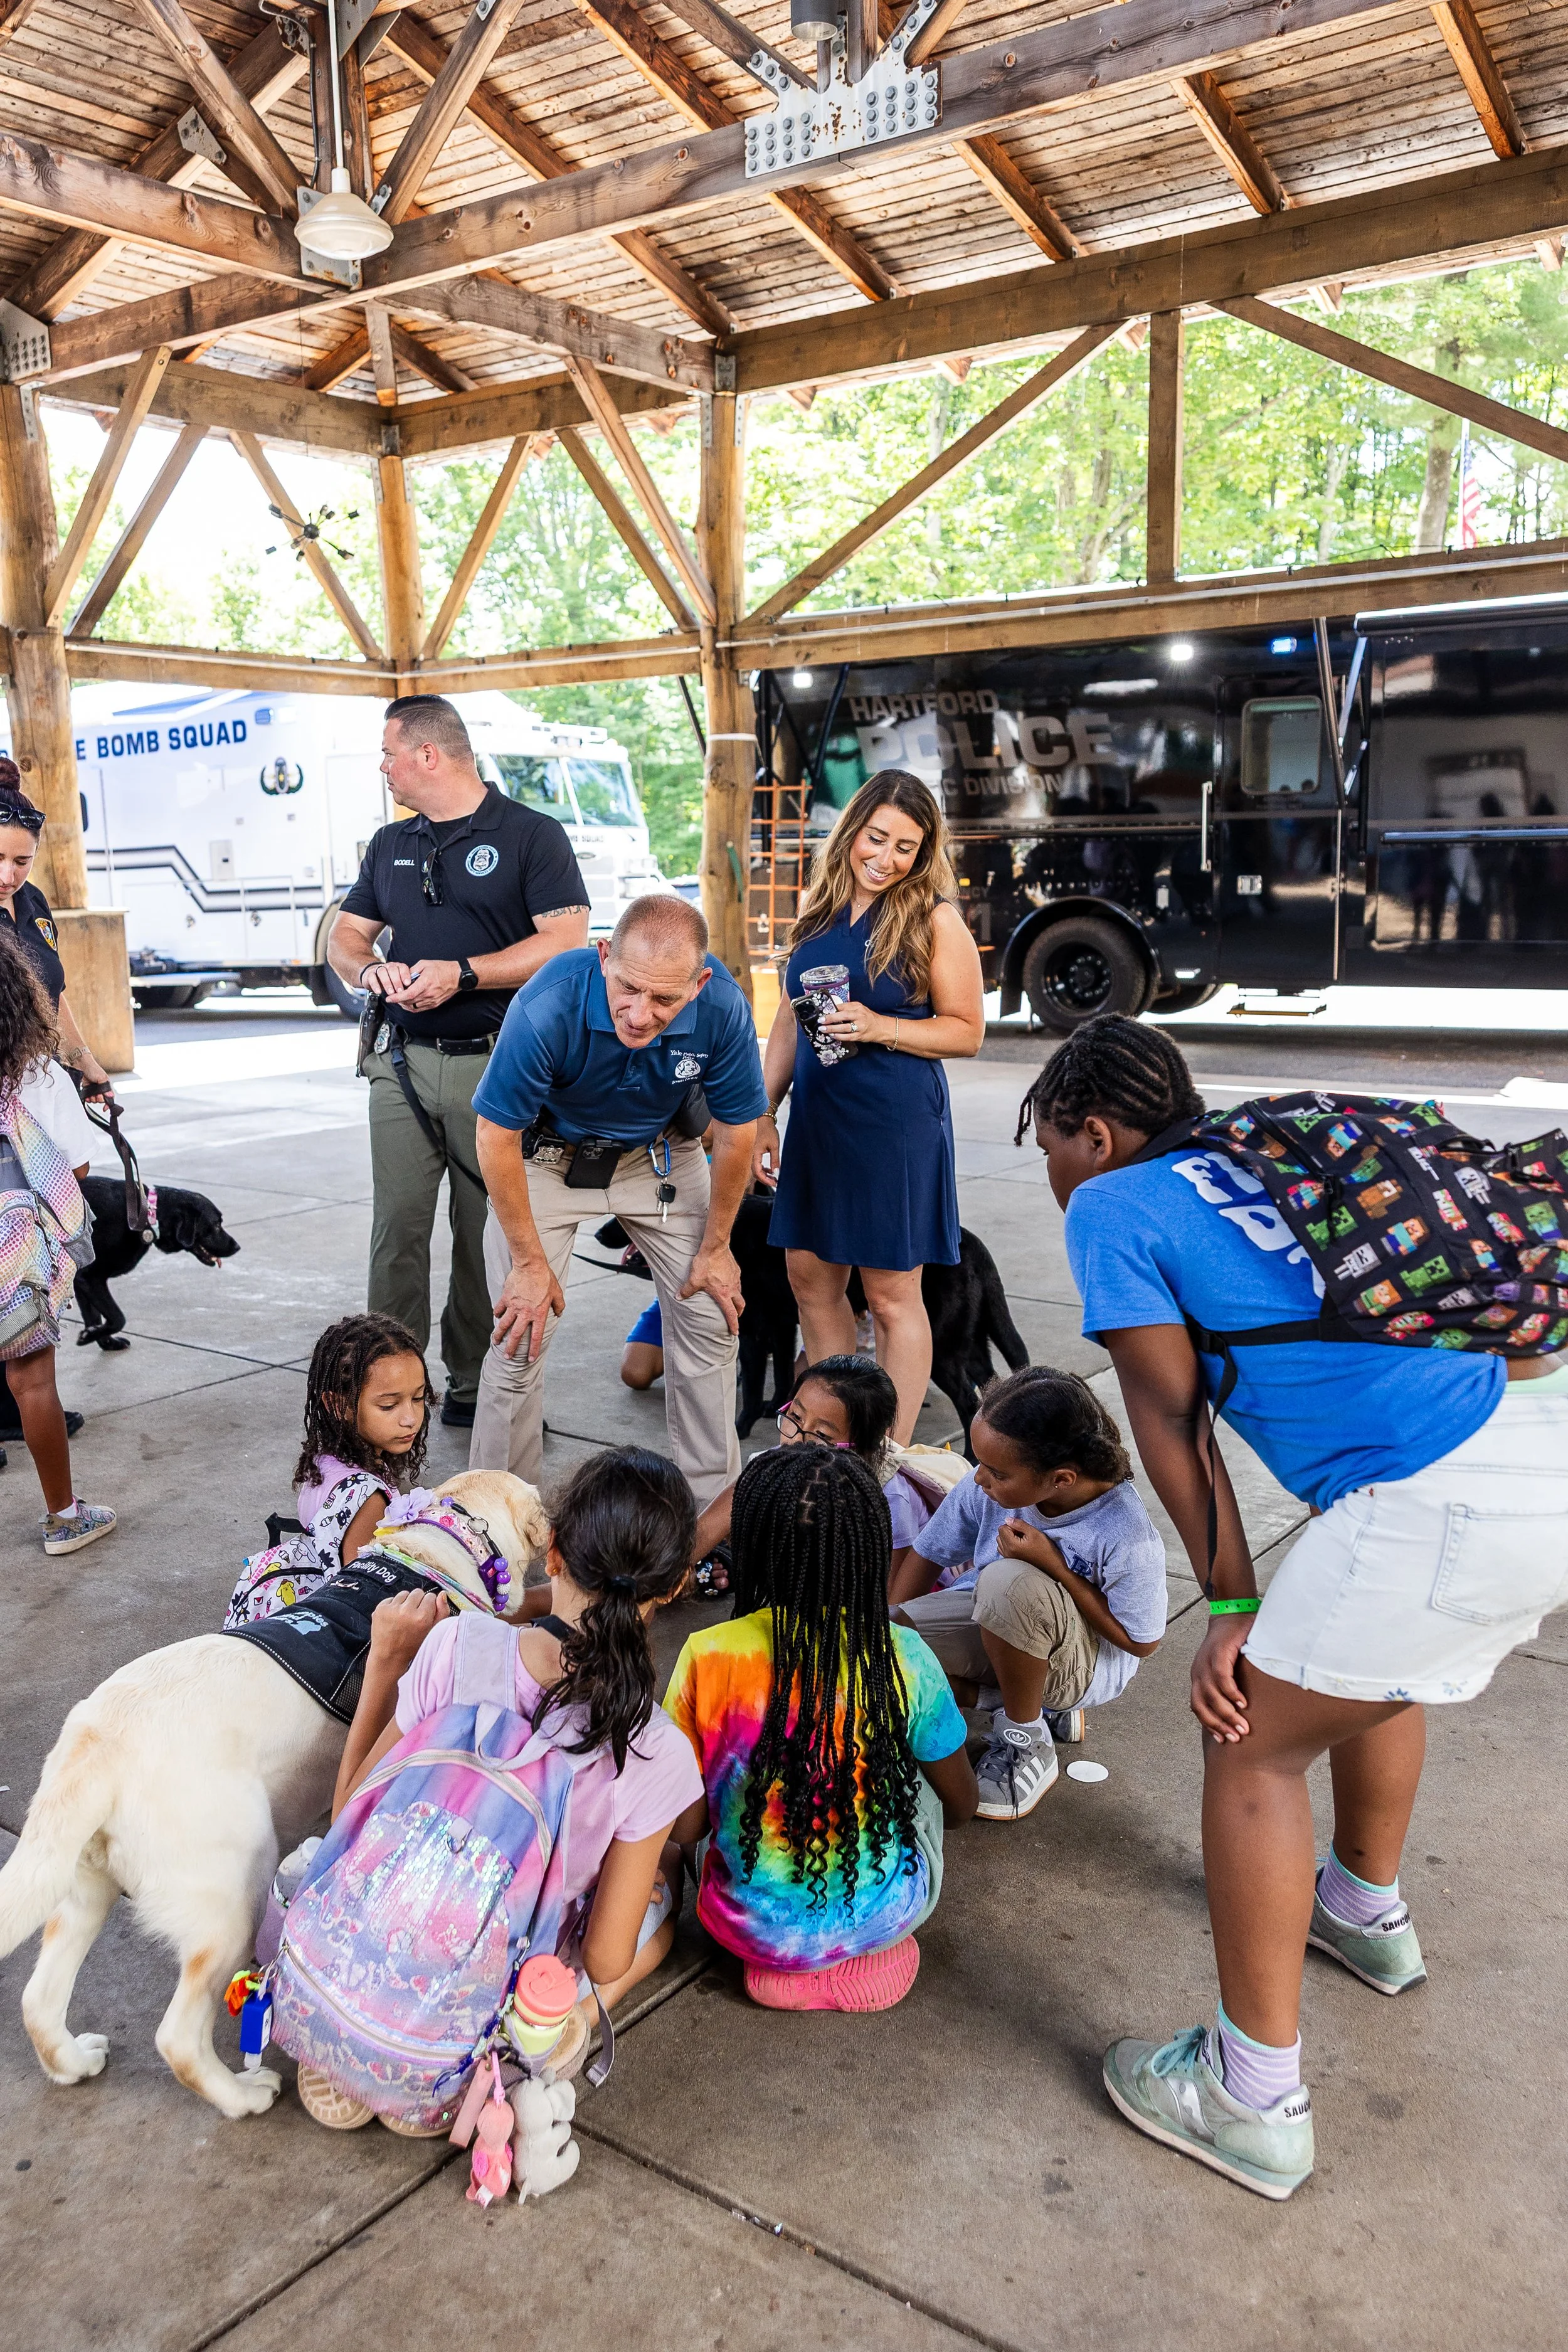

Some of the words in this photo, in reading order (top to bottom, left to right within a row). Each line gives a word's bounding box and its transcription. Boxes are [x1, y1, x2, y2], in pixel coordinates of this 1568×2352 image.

[850, 689, 999, 721] HARTFORD
[97, 730, 159, 758] BOMB
[168, 719, 247, 750] SQUAD
[857, 711, 1116, 773] POLICE
[251, 1568, 265, 1586] AND
[347, 1561, 379, 1573] Facility
[375, 1567, 397, 1582] Dog
[1381, 1912, 1411, 1932] SAUCO
[1284, 2098, 1311, 2118] SAUC
